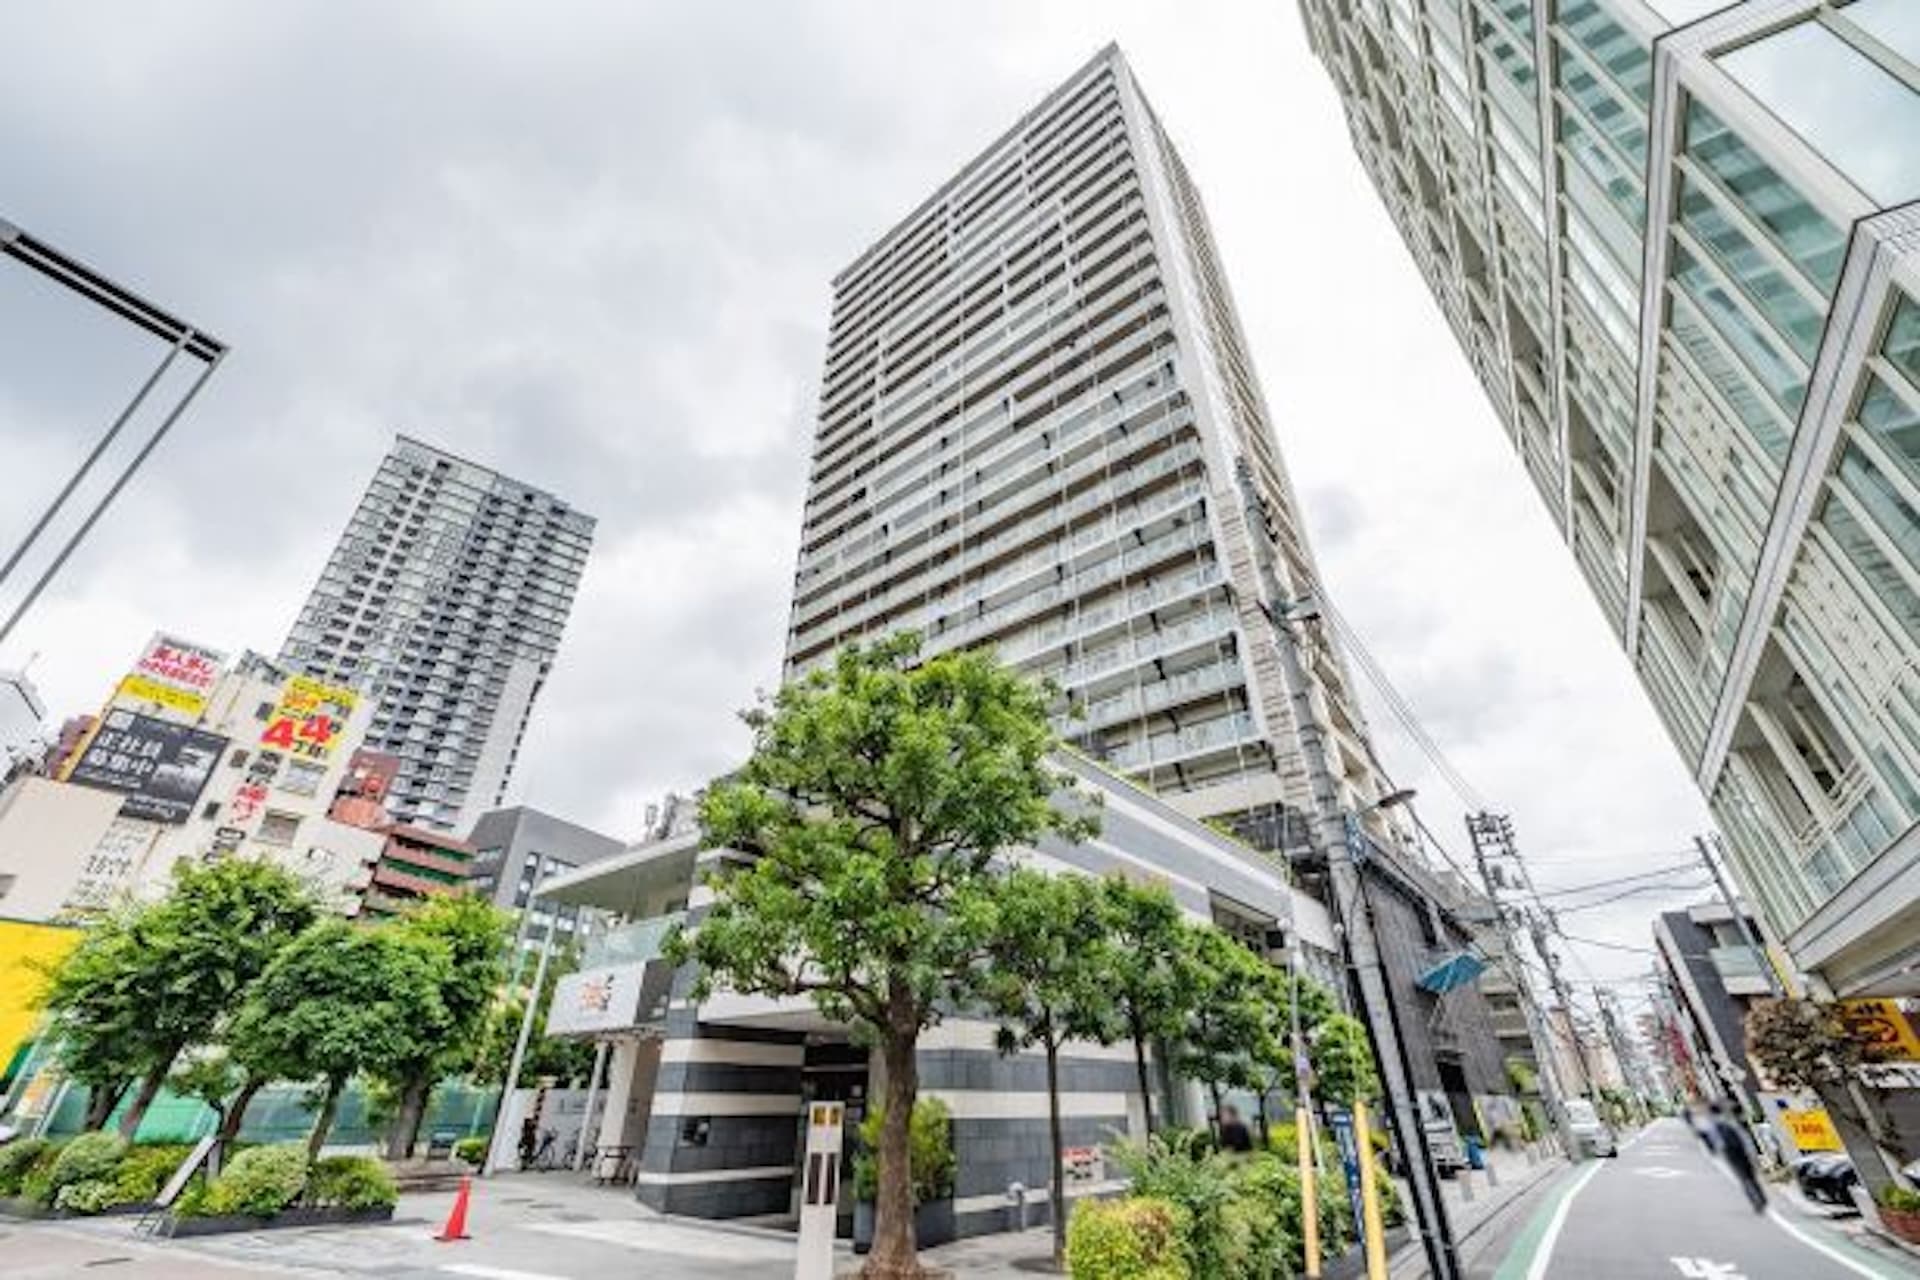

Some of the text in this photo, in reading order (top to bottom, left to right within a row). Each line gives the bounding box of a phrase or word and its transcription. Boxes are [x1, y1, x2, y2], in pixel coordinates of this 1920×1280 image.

[99, 730, 163, 759] 正社員
[89, 748, 155, 776] 募集中
